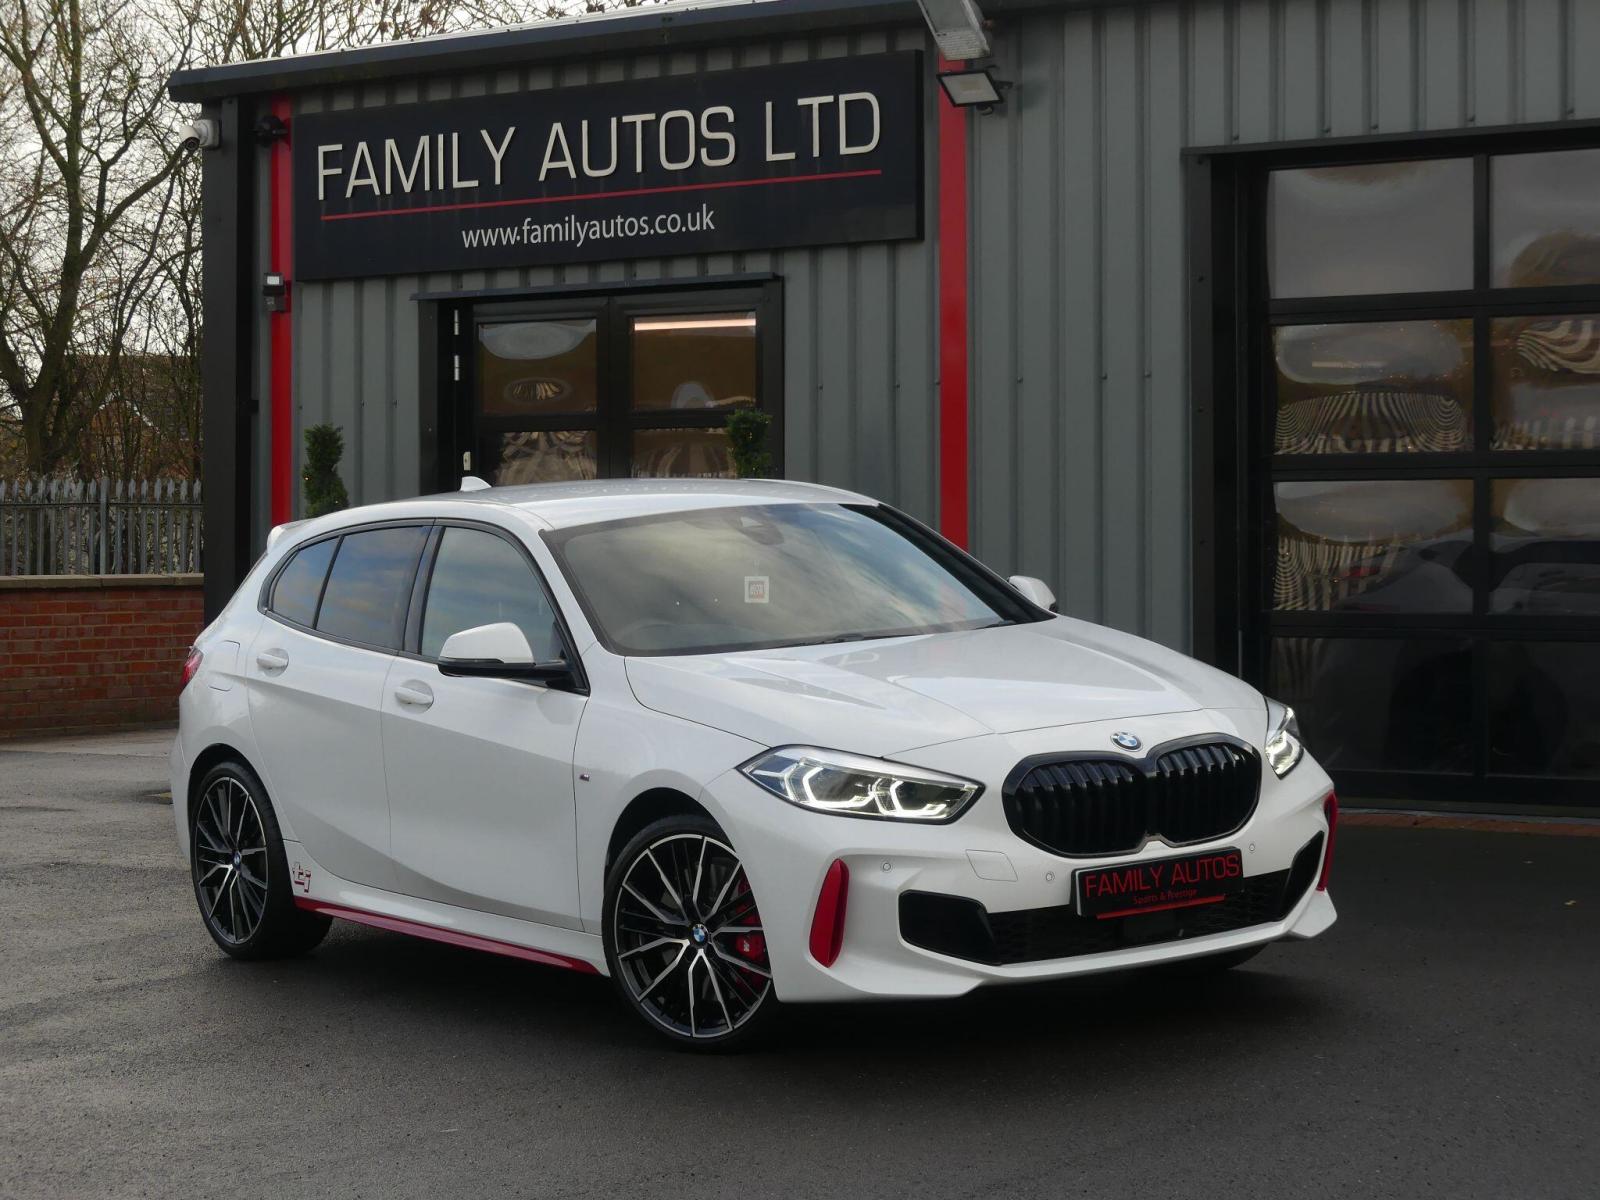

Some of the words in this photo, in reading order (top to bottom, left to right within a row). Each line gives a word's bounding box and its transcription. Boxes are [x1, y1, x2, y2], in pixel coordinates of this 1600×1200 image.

[317, 125, 516, 201] FAMILY
[537, 105, 737, 182] AUTOS
[765, 91, 882, 162] LTD
[461, 204, 716, 249] www.familyautos.co.uk
[1085, 863, 1164, 897] FAMILY
[1171, 854, 1241, 886] AUTOS
